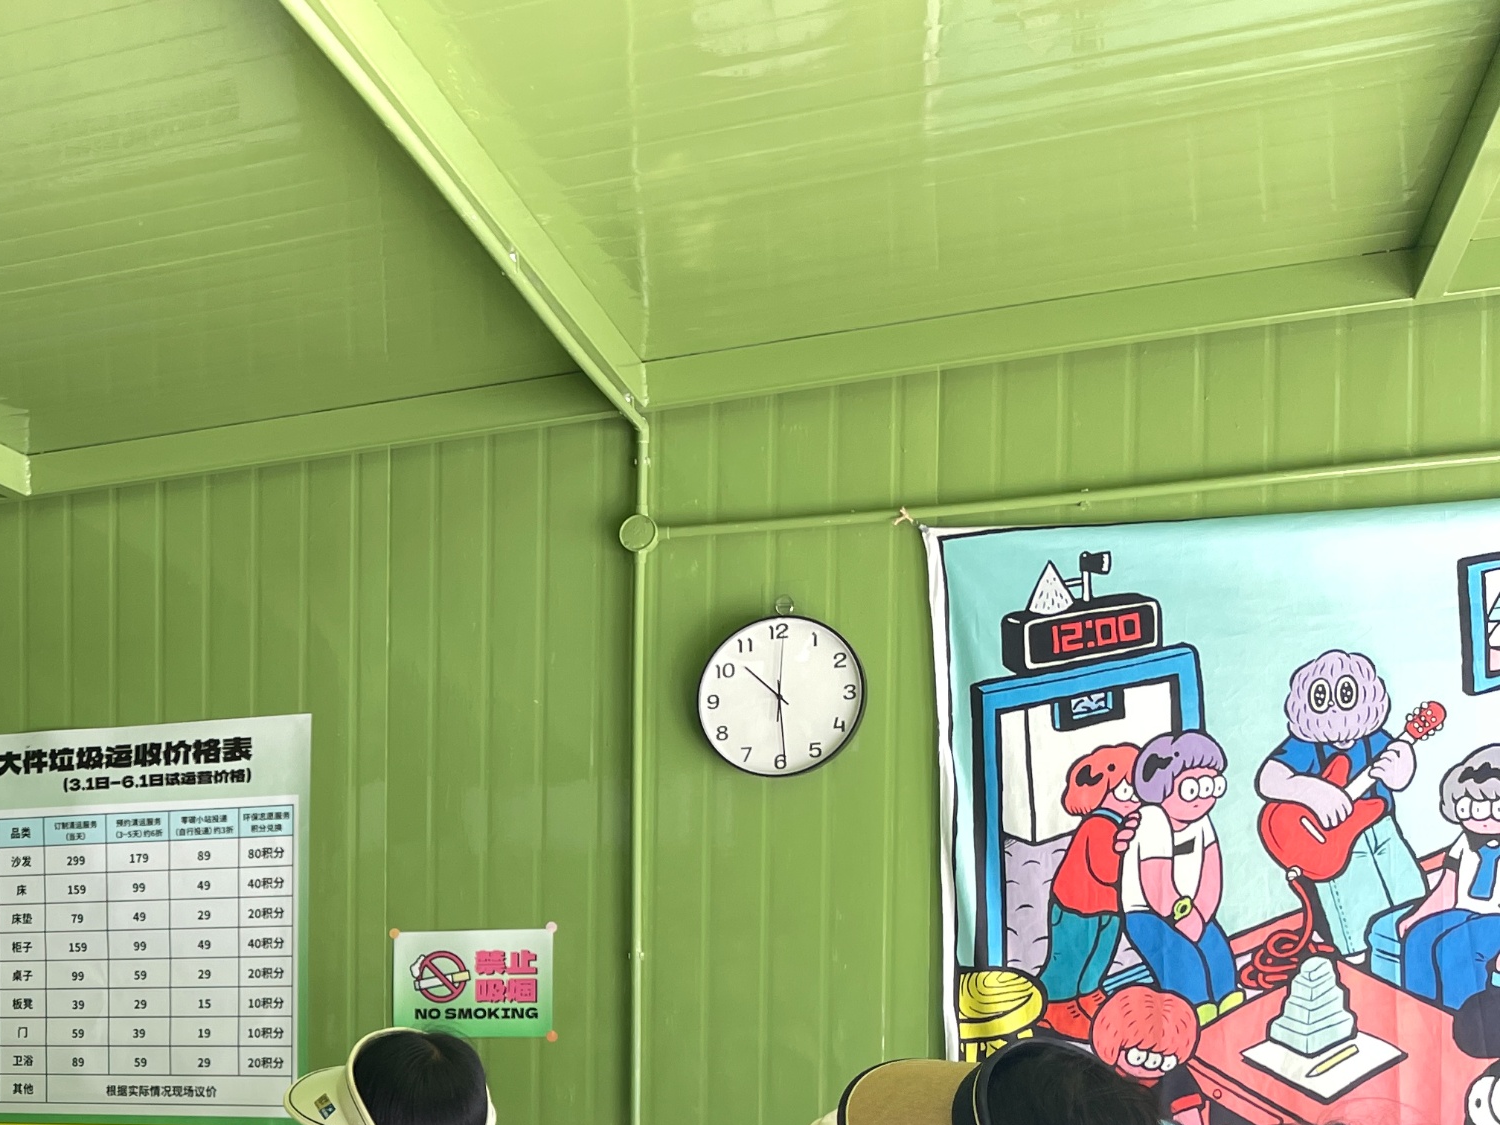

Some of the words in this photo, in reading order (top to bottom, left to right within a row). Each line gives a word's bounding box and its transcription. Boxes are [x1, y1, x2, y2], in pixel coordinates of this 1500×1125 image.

[769, 623, 789, 640] 12
[812, 632, 817, 646] 1
[1051, 613, 1140, 654] 12:00
[737, 638, 753, 653] 11
[833, 653, 847, 668] 2
[716, 663, 735, 678] 10
[843, 684, 856, 700] 3
[707, 695, 720, 709] 9
[833, 717, 845, 732] 4
[716, 726, 728, 740] 8
[741, 747, 752, 762] 7
[809, 743, 821, 758] 5
[774, 754, 787, 769] 6
[10, 826, 31, 840] 品类
[10, 855, 32, 868] 沙发
[66, 855, 86, 867] 299
[129, 853, 149, 864] 179
[196, 850, 212, 862] 89
[247, 846, 285, 860] 80积分
[16, 884, 27, 897] 床
[67, 884, 87, 895] 159
[132, 882, 146, 893] 99
[196, 880, 211, 891] 49
[247, 876, 285, 890] 40积分
[11, 912, 33, 925] 床垫
[70, 913, 84, 924] 79
[132, 911, 147, 922] 49
[197, 909, 212, 921] 29
[247, 906, 285, 920] 20积分
[11, 941, 33, 954] 柜子
[68, 942, 88, 953] 159
[132, 940, 147, 952] 99
[197, 939, 212, 950] 49
[247, 936, 285, 950] 40积分
[474, 950, 537, 974] 禁止
[12, 969, 34, 982] 桌子
[71, 971, 85, 982] 99
[133, 970, 148, 981] 59
[197, 969, 212, 980] 29
[247, 966, 285, 980] 20积分
[475, 979, 537, 1003] 吸烟
[12, 997, 34, 1010] 板凳
[71, 999, 85, 1010] 39
[133, 999, 148, 1010] 29
[197, 998, 212, 1009] 15
[248, 996, 285, 1010] 10积分
[415, 1008, 440, 1019] NO
[445, 1007, 538, 1019] SMOKING
[17, 1026, 28, 1039] 门
[71, 1028, 85, 1039] 59
[132, 1028, 146, 1039] 39
[197, 1028, 212, 1039] 19
[247, 1026, 285, 1040] 10积分
[12, 1054, 34, 1067] 卫浴
[71, 1056, 85, 1068] 89
[133, 1057, 148, 1068] 59
[197, 1057, 211, 1068] 29
[247, 1056, 285, 1070] 20积分
[12, 1082, 34, 1095] 其他
[105, 1084, 217, 1098] 根据实际情况现场议价
